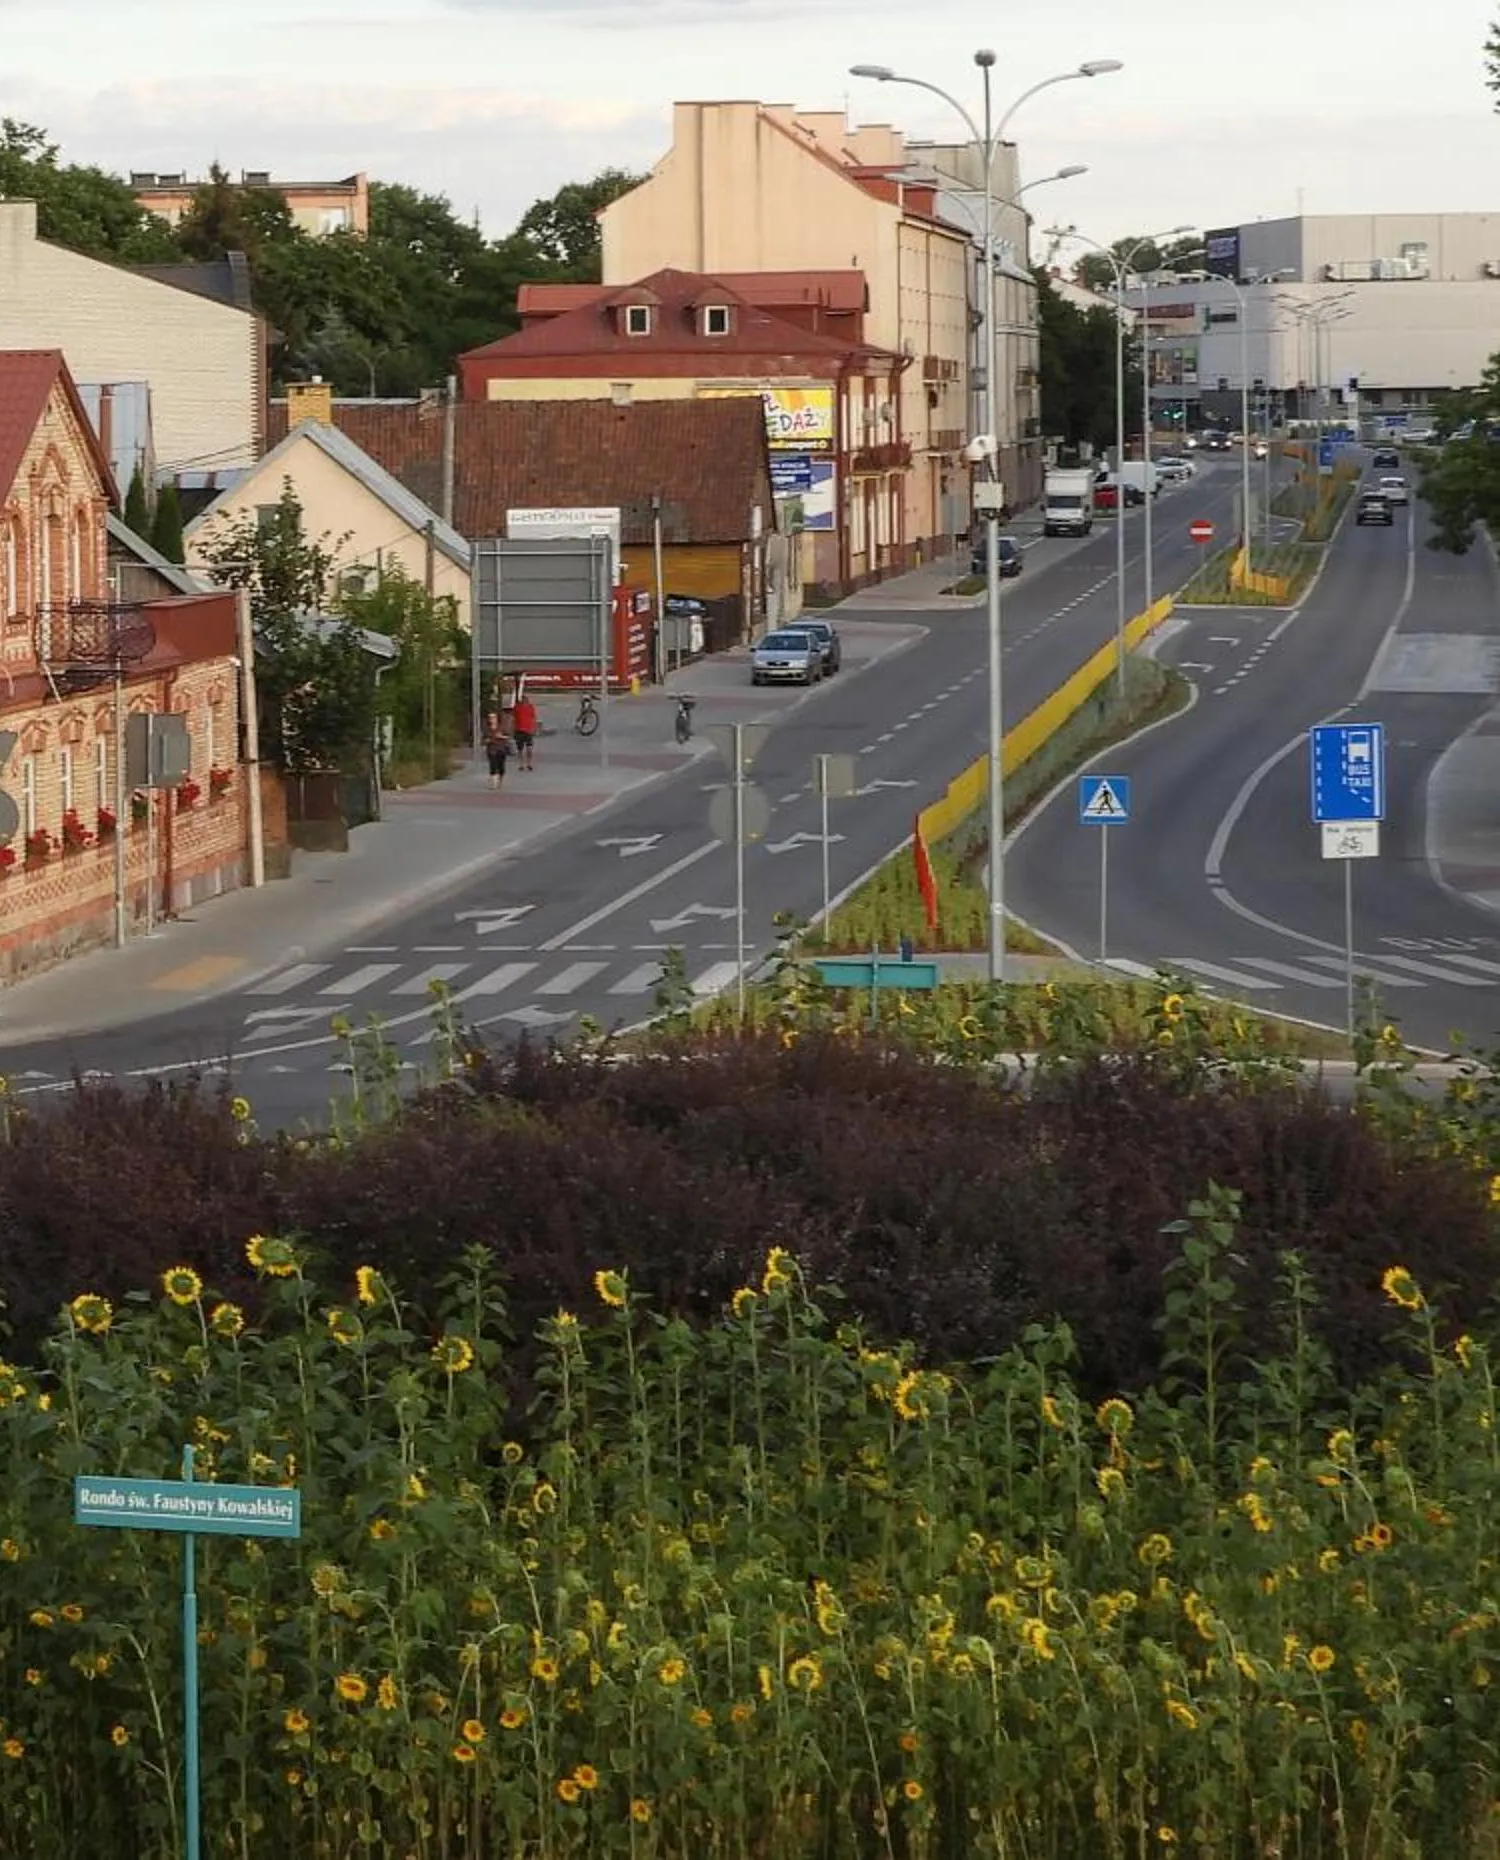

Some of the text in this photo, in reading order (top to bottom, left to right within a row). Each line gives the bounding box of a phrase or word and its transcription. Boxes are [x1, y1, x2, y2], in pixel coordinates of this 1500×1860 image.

[80, 1487, 293, 1521] Rondo św. Faustyny Kowalskiej
